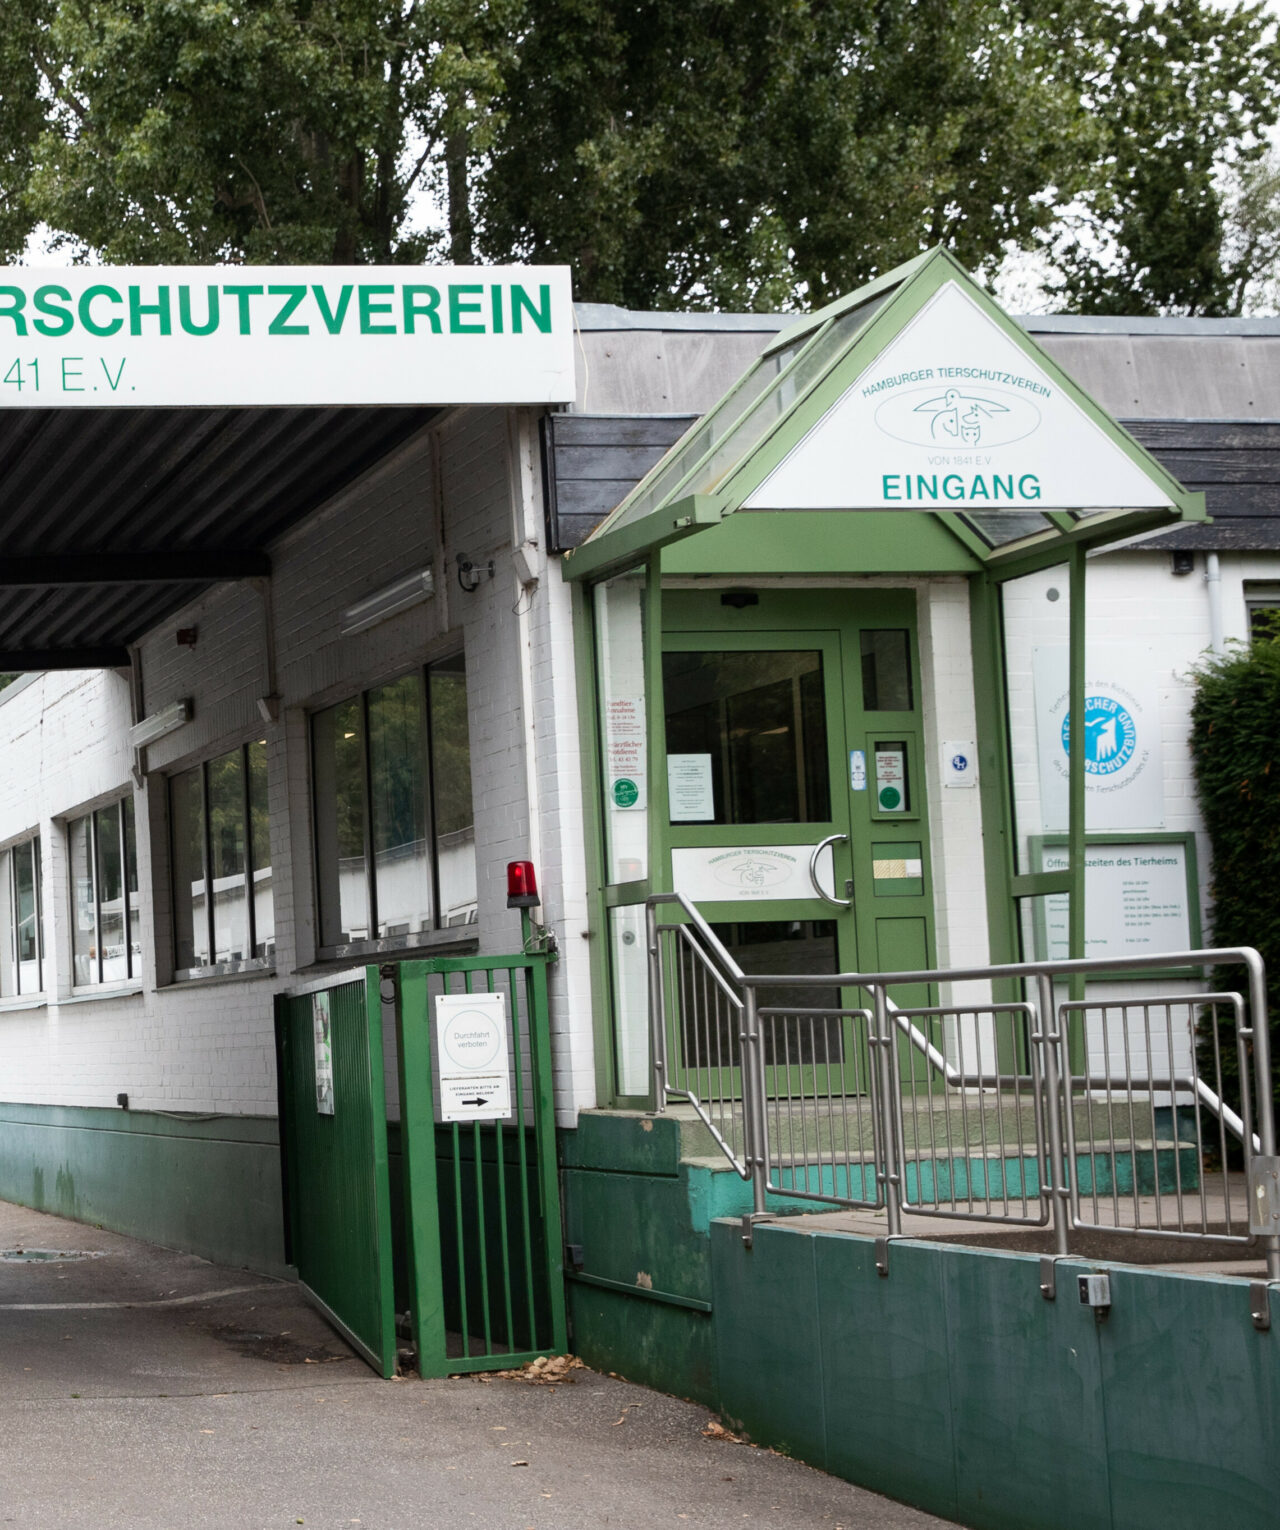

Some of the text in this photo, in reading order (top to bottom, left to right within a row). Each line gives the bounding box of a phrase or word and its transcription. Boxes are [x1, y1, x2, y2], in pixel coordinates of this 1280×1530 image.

[61, 356, 138, 393] E.V.
[862, 367, 1052, 399] HAMBURGER TIERSCHUTZVEREIN
[882, 473, 1041, 501] EINGANG
[1116, 857, 1132, 868] des
[1134, 856, 1178, 867] Tierheims
[454, 1031, 490, 1041] Durchfahrt
[457, 1039, 488, 1049] verboten
